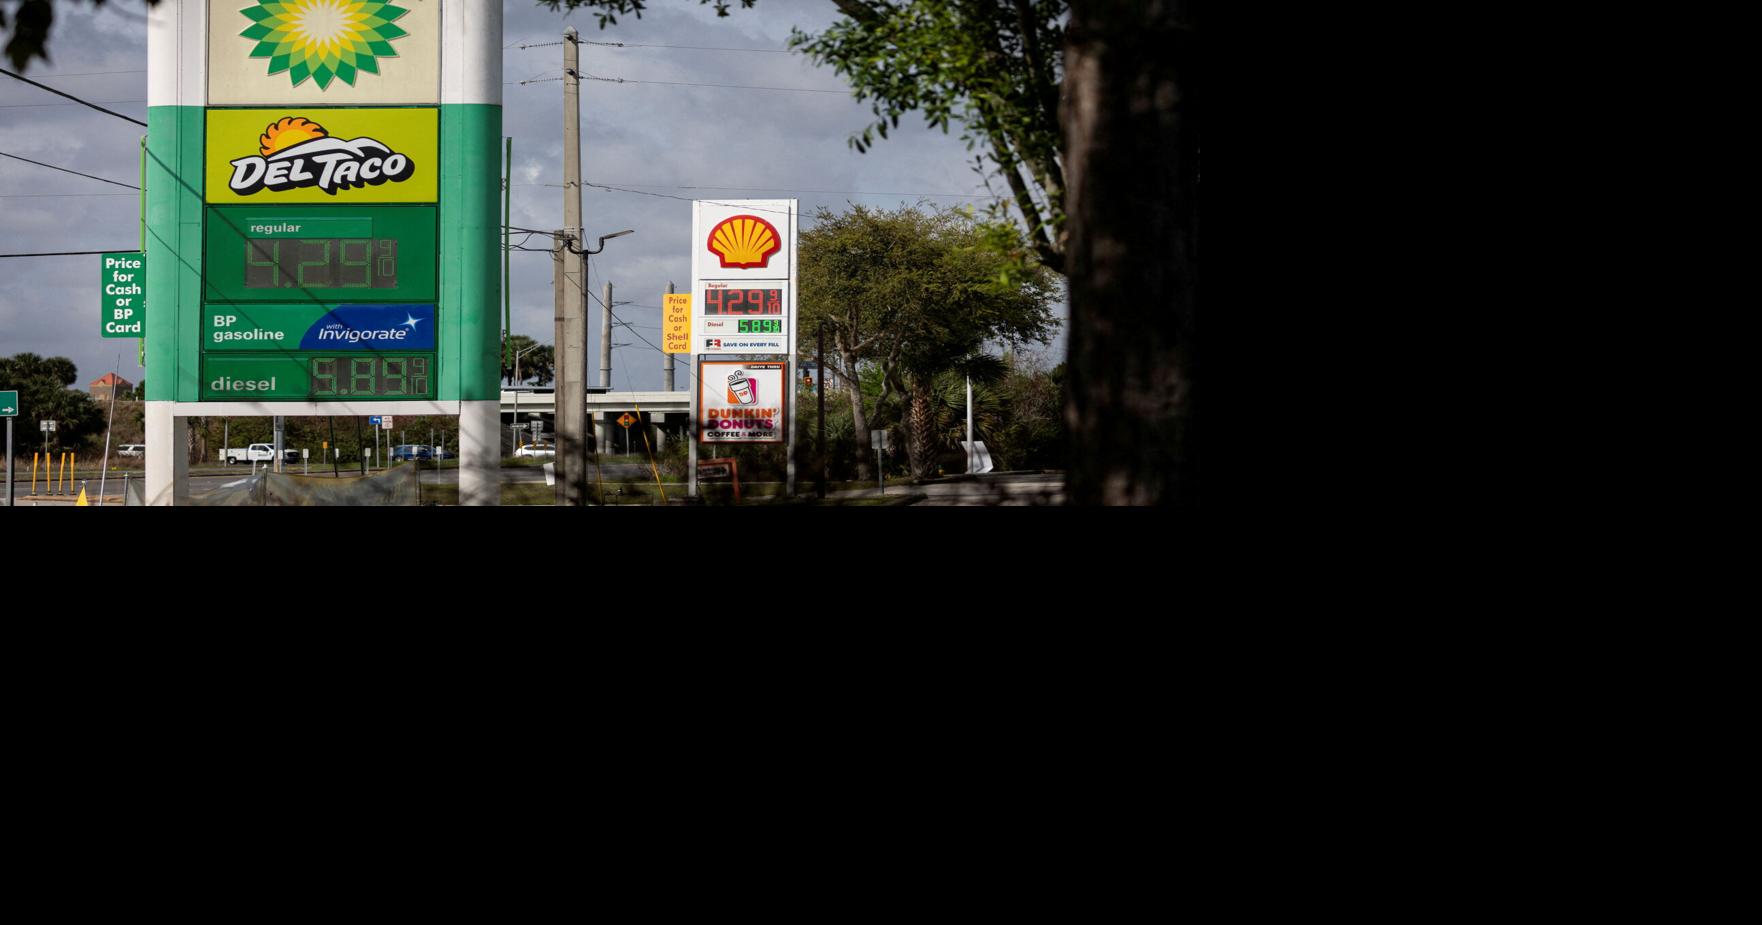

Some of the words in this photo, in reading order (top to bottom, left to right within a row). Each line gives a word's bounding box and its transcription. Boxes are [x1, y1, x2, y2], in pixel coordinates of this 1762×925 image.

[250, 222, 302, 235] regular
[105, 258, 141, 269] Price
[113, 271, 134, 282] for
[105, 283, 142, 295] Cash
[116, 298, 132, 306] or
[668, 296, 687, 304] Price
[114, 309, 133, 320] BP
[672, 305, 683, 313] for
[213, 315, 237, 327] BP
[668, 314, 688, 322] Cash
[105, 321, 141, 333] Card
[213, 329, 285, 342] gasoline
[666, 333, 689, 341] Shell
[668, 341, 687, 350] Card
[210, 377, 276, 391] diesel
[705, 419, 774, 430] DONUTS
